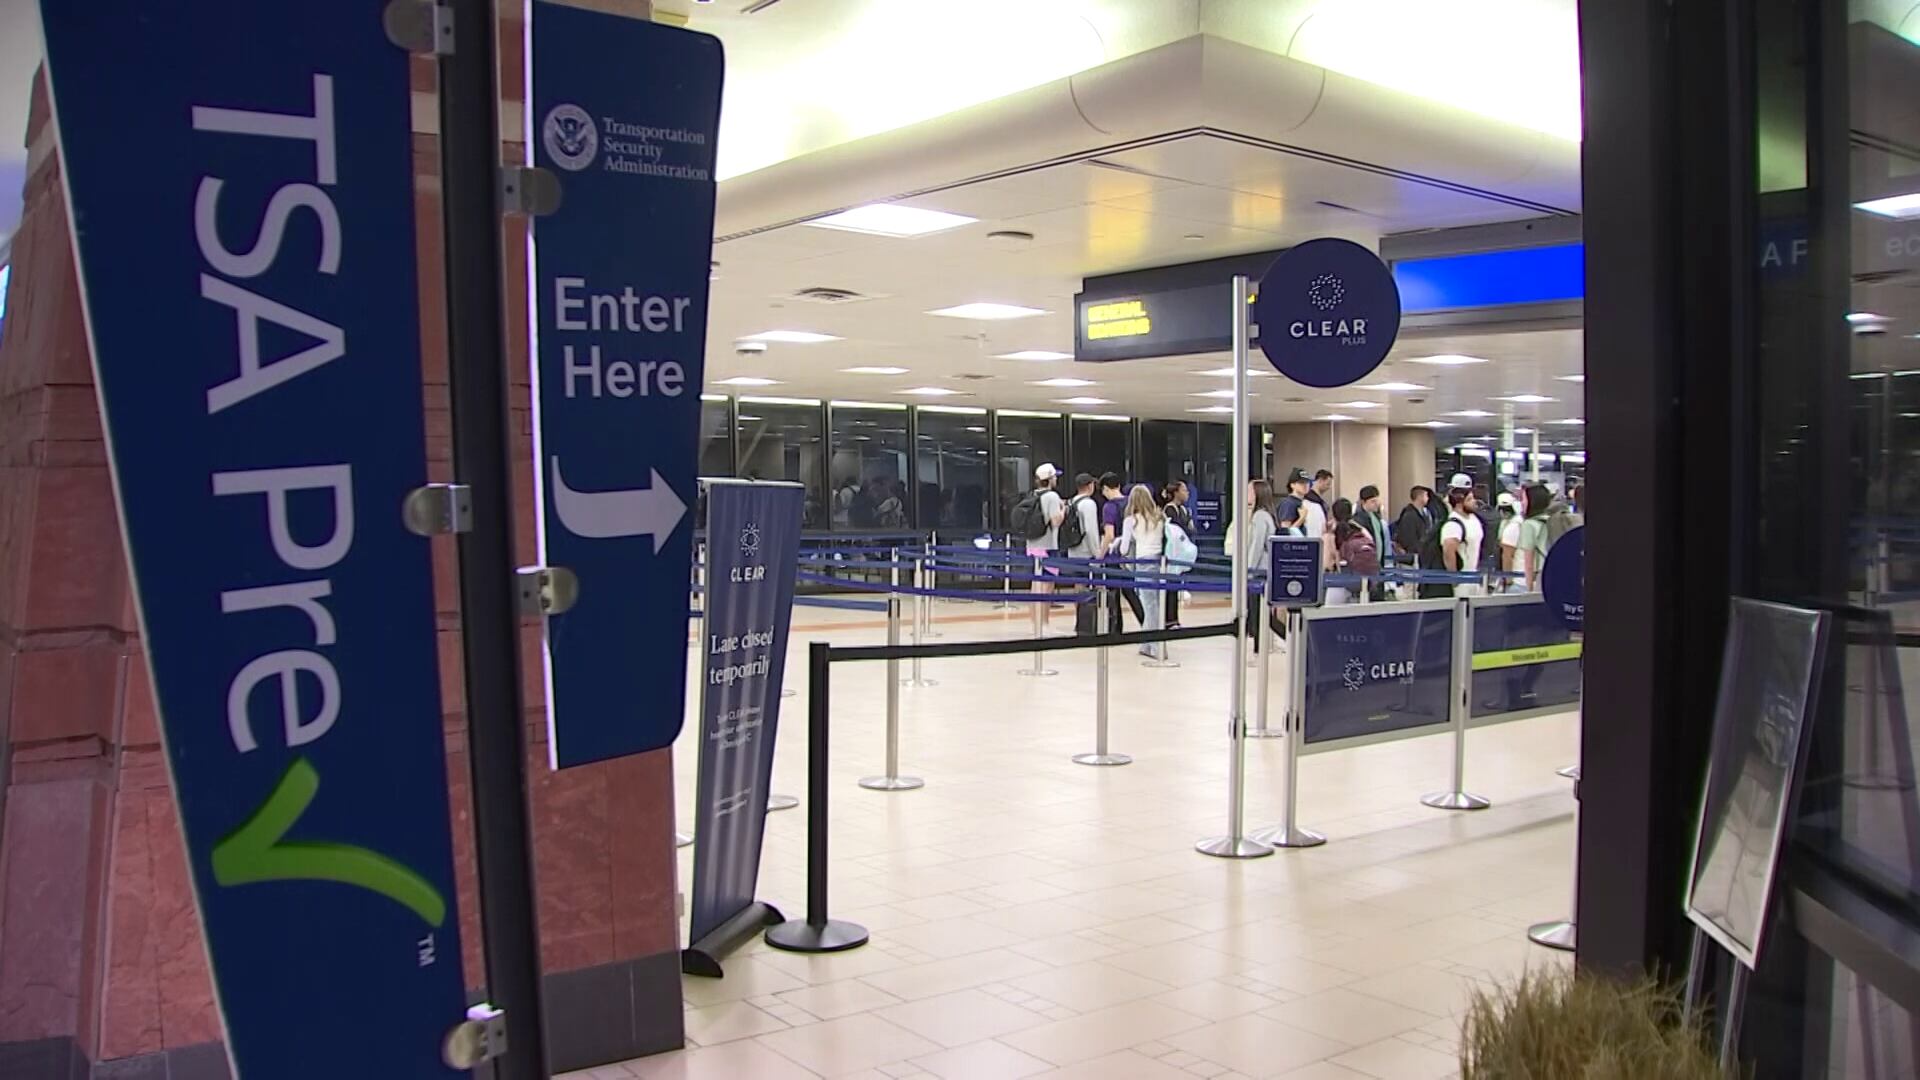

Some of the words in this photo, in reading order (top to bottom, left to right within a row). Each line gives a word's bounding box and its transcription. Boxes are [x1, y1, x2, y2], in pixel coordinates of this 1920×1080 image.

[602, 116, 706, 145] Transportation
[603, 136, 664, 162] Security
[604, 155, 709, 182] Administration
[192, 73, 346, 415] TSA
[555, 276, 691, 333] Enter
[1289, 318, 1367, 339] CLEAR
[1341, 336, 1367, 346] PLUS
[563, 344, 686, 399] Here
[730, 564, 766, 583] CLEAR
[212, 463, 354, 753] Pre
[709, 654, 771, 687] temporarily
[1371, 660, 1415, 679] CLEAR
